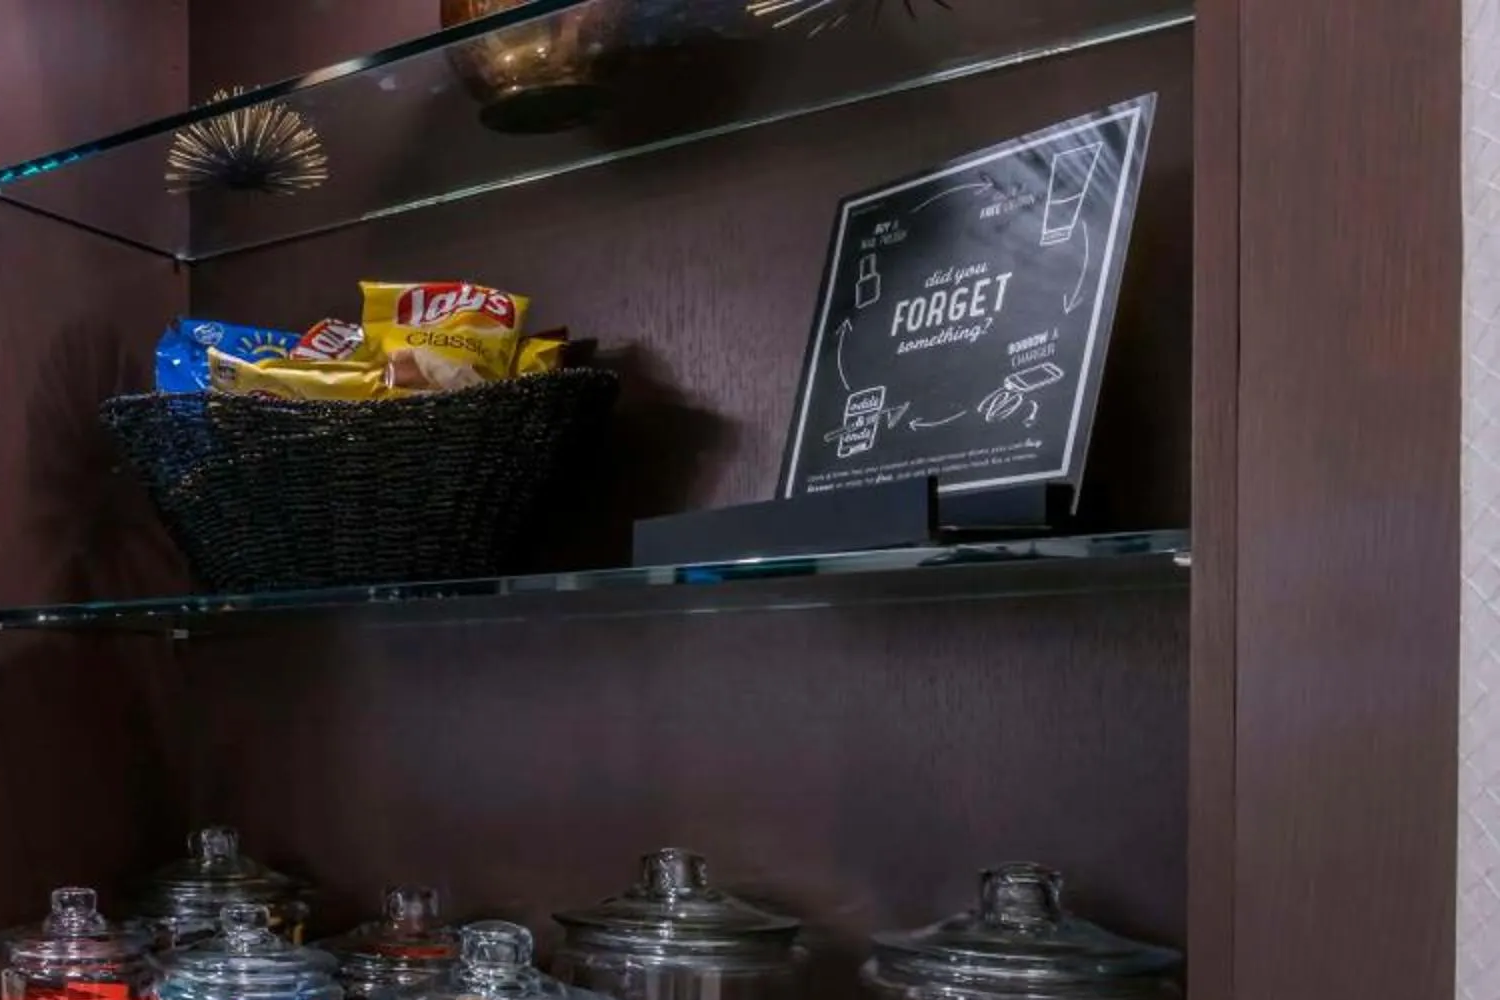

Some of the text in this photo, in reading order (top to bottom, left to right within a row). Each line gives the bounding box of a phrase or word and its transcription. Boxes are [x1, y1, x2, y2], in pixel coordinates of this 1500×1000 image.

[925, 262, 988, 289] did you
[409, 281, 509, 329] Lay's
[890, 271, 1013, 337] FORGET
[896, 316, 994, 355] something?
[1007, 330, 1049, 356] BORROW
[1011, 342, 1057, 368] CHARGER
